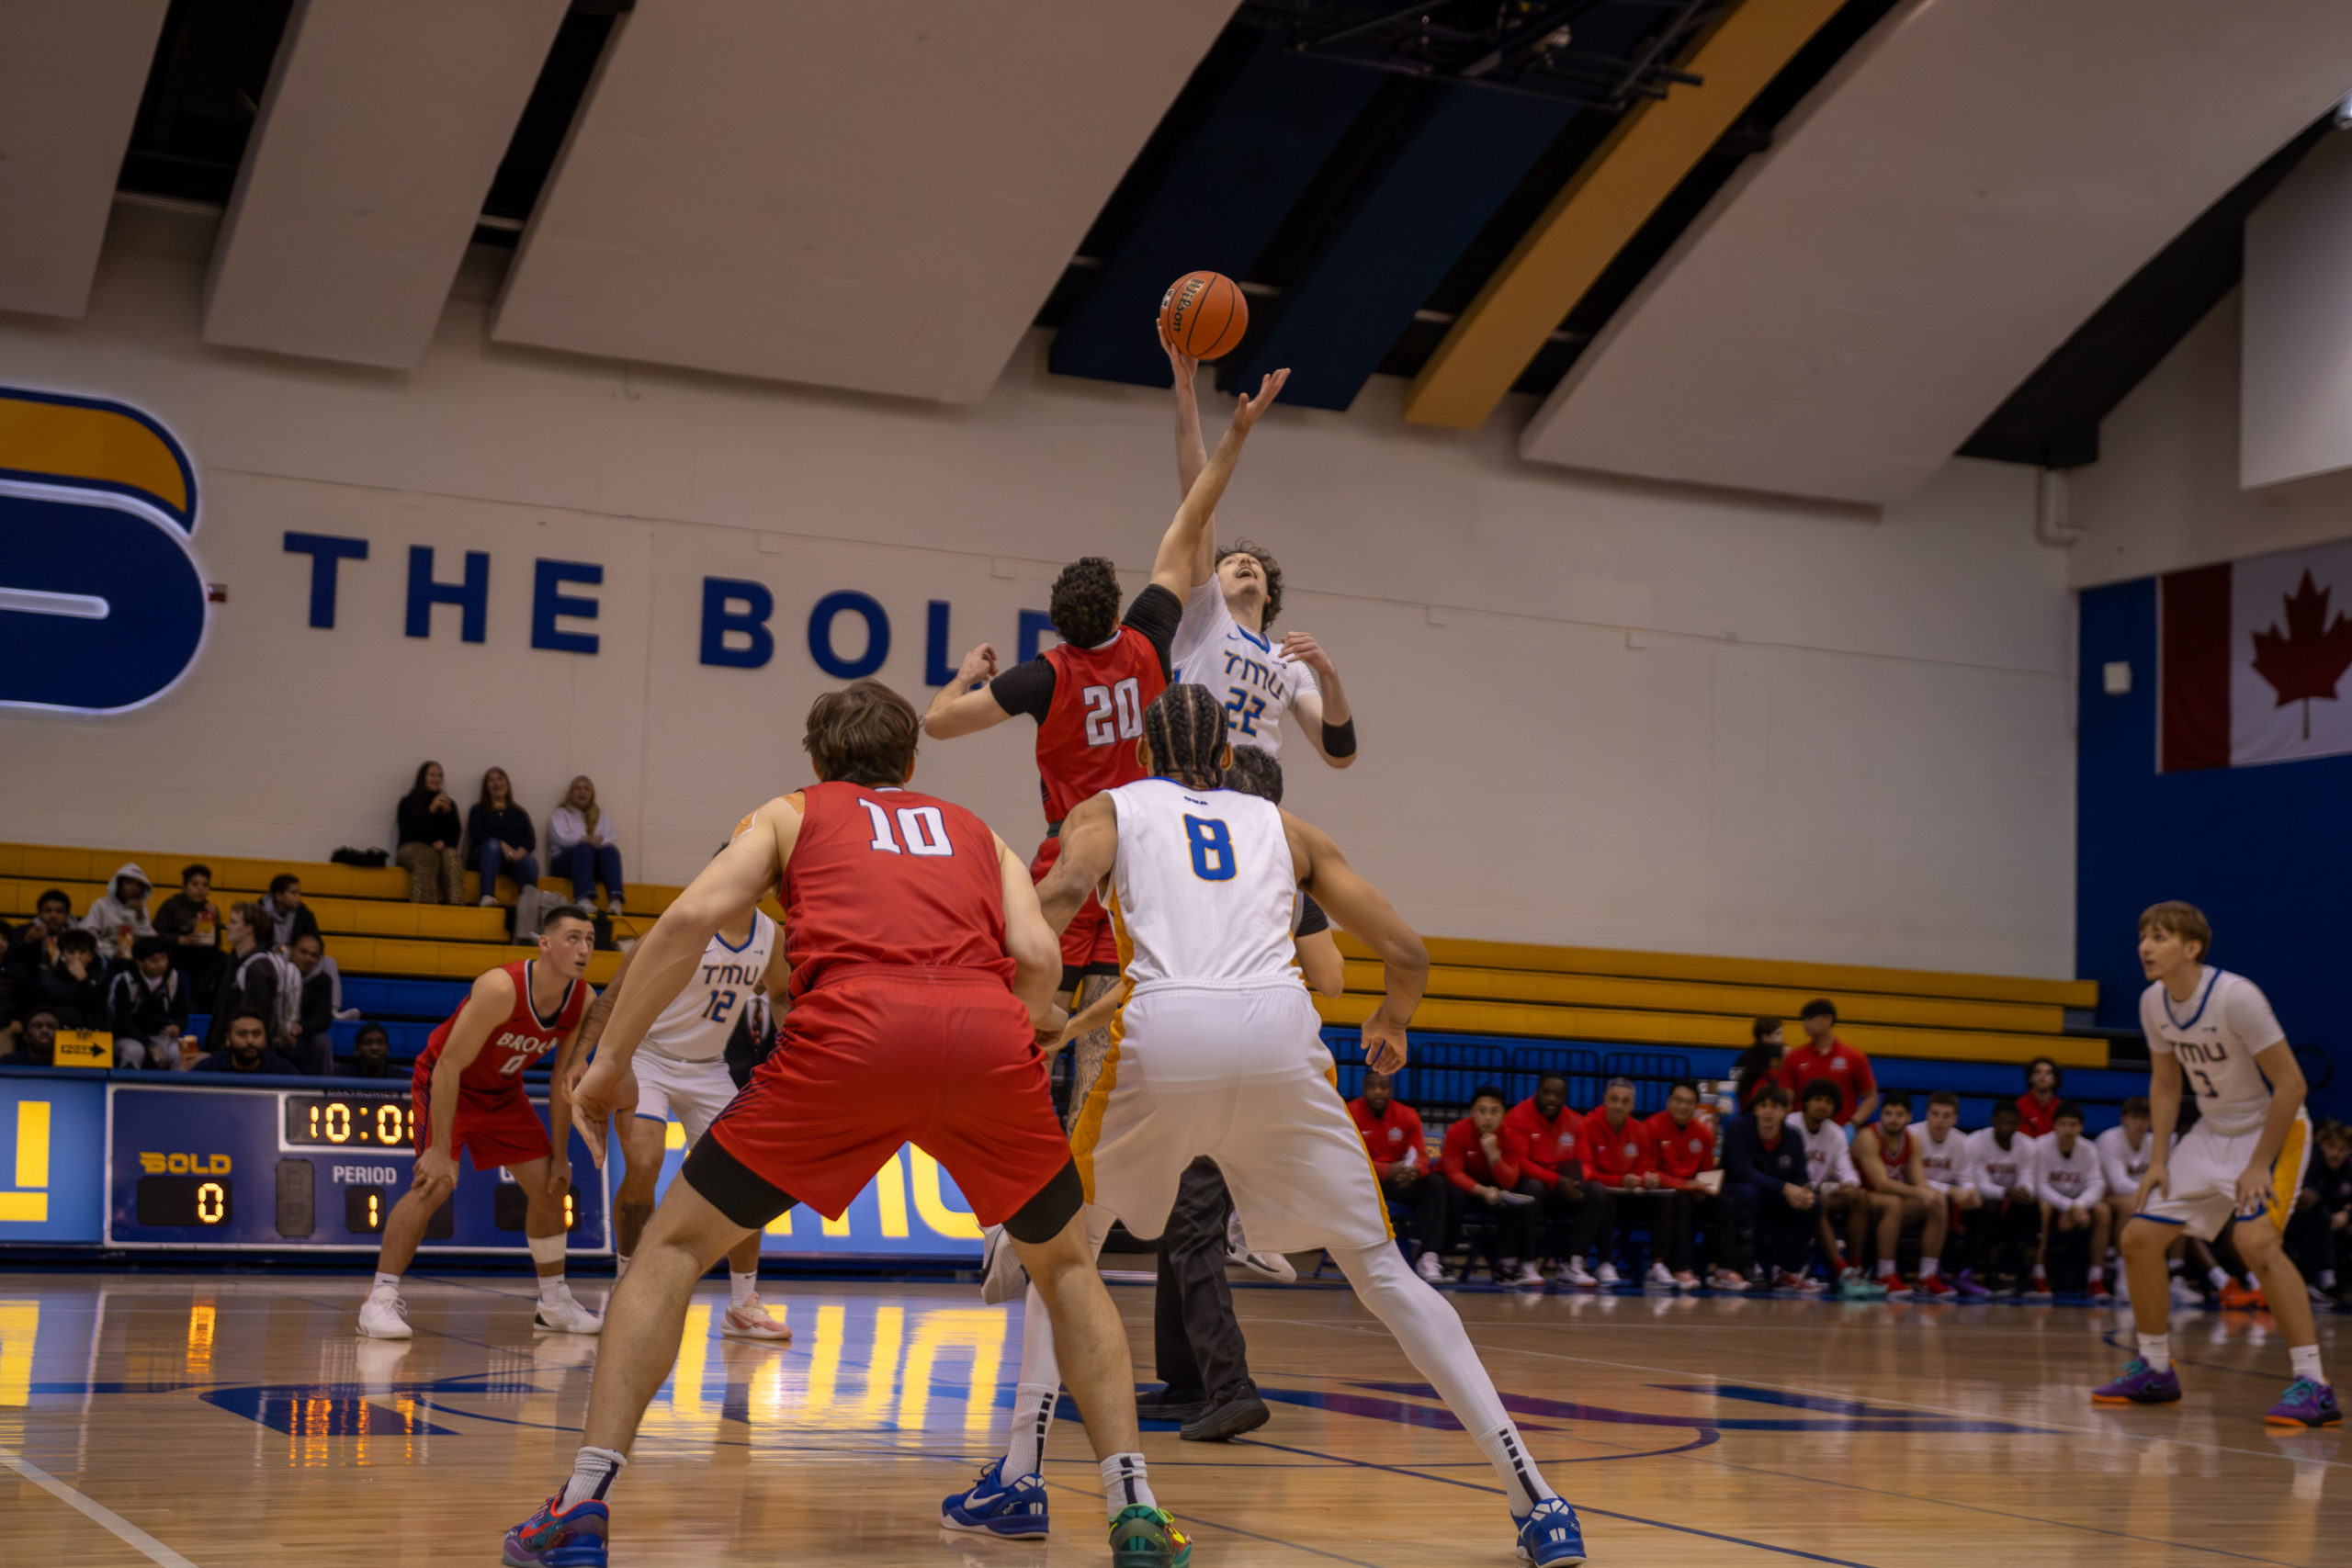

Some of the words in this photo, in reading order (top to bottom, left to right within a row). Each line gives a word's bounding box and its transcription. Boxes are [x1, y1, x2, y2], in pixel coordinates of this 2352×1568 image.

[1173, 279, 1205, 333] Wilson
[283, 530, 604, 656] THE
[1224, 649, 1284, 700] TMU
[1082, 676, 1143, 747] 20
[1225, 686, 1267, 738] 22
[856, 796, 955, 857] 10
[1182, 812, 1238, 883] 8
[702, 964, 759, 986] TMU
[702, 989, 737, 1023] 12
[498, 1054, 528, 1075] 0
[2169, 1042, 2229, 1063] MU
[309, 1102, 414, 1145] 10:0
[139, 1152, 232, 1175] BOLD
[333, 1165, 397, 1184] PERIOD
[198, 1182, 224, 1224] 0
[368, 1194, 379, 1228] 1
